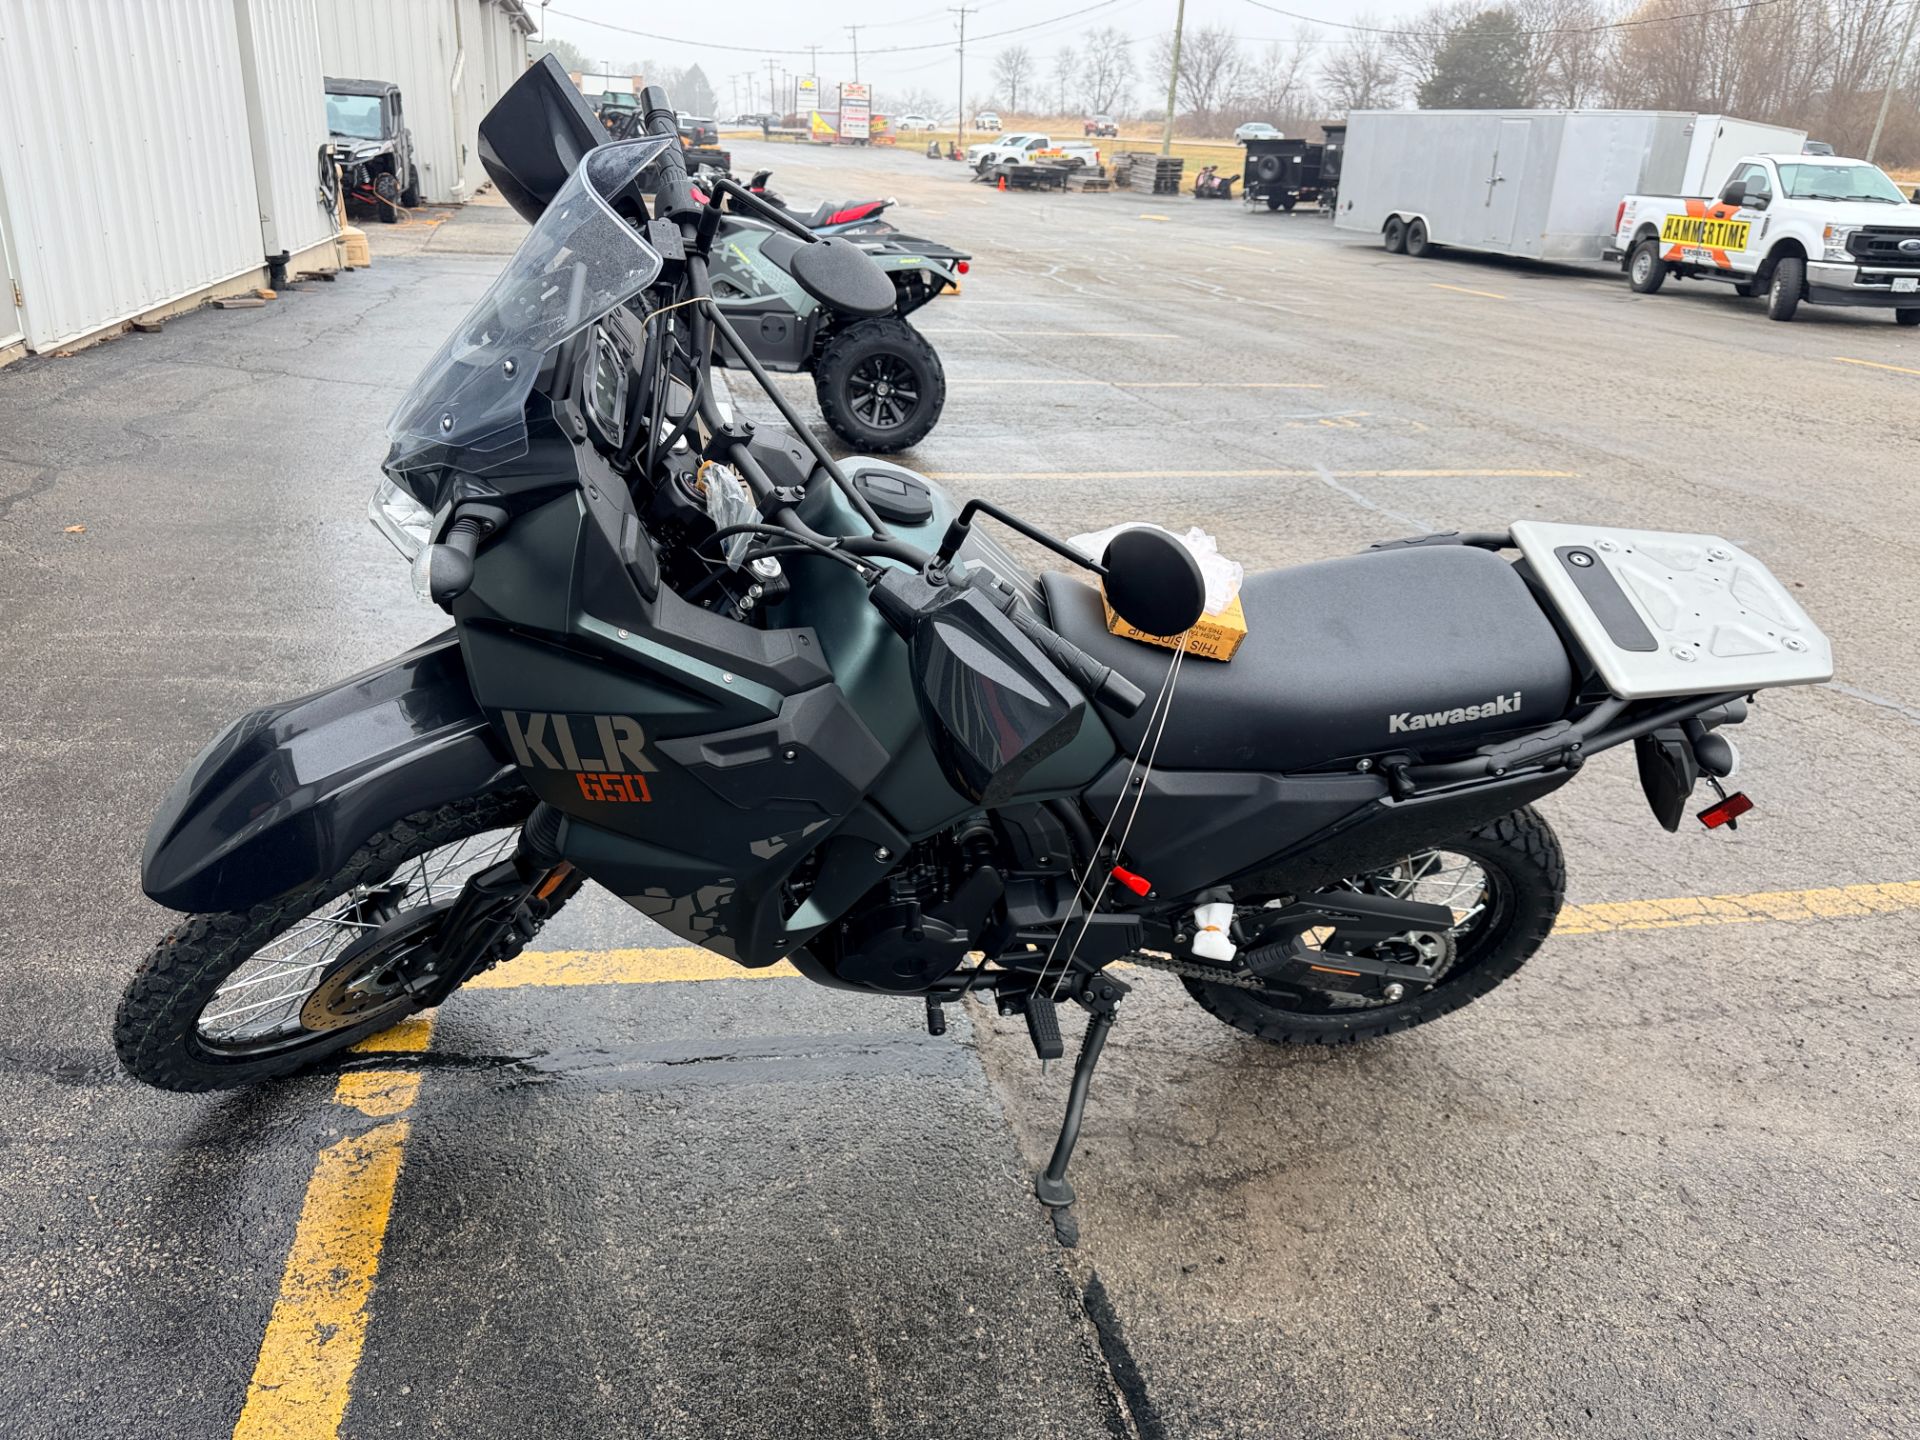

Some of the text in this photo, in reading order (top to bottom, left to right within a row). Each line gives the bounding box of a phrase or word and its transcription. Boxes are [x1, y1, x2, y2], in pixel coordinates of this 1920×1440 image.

[1663, 217, 1747, 249] HAMMERTIME
[1190, 640, 1218, 655] THIS
[1389, 691, 1522, 734] Kawasaki
[501, 709, 660, 772] KLR
[576, 773, 653, 802] 650
